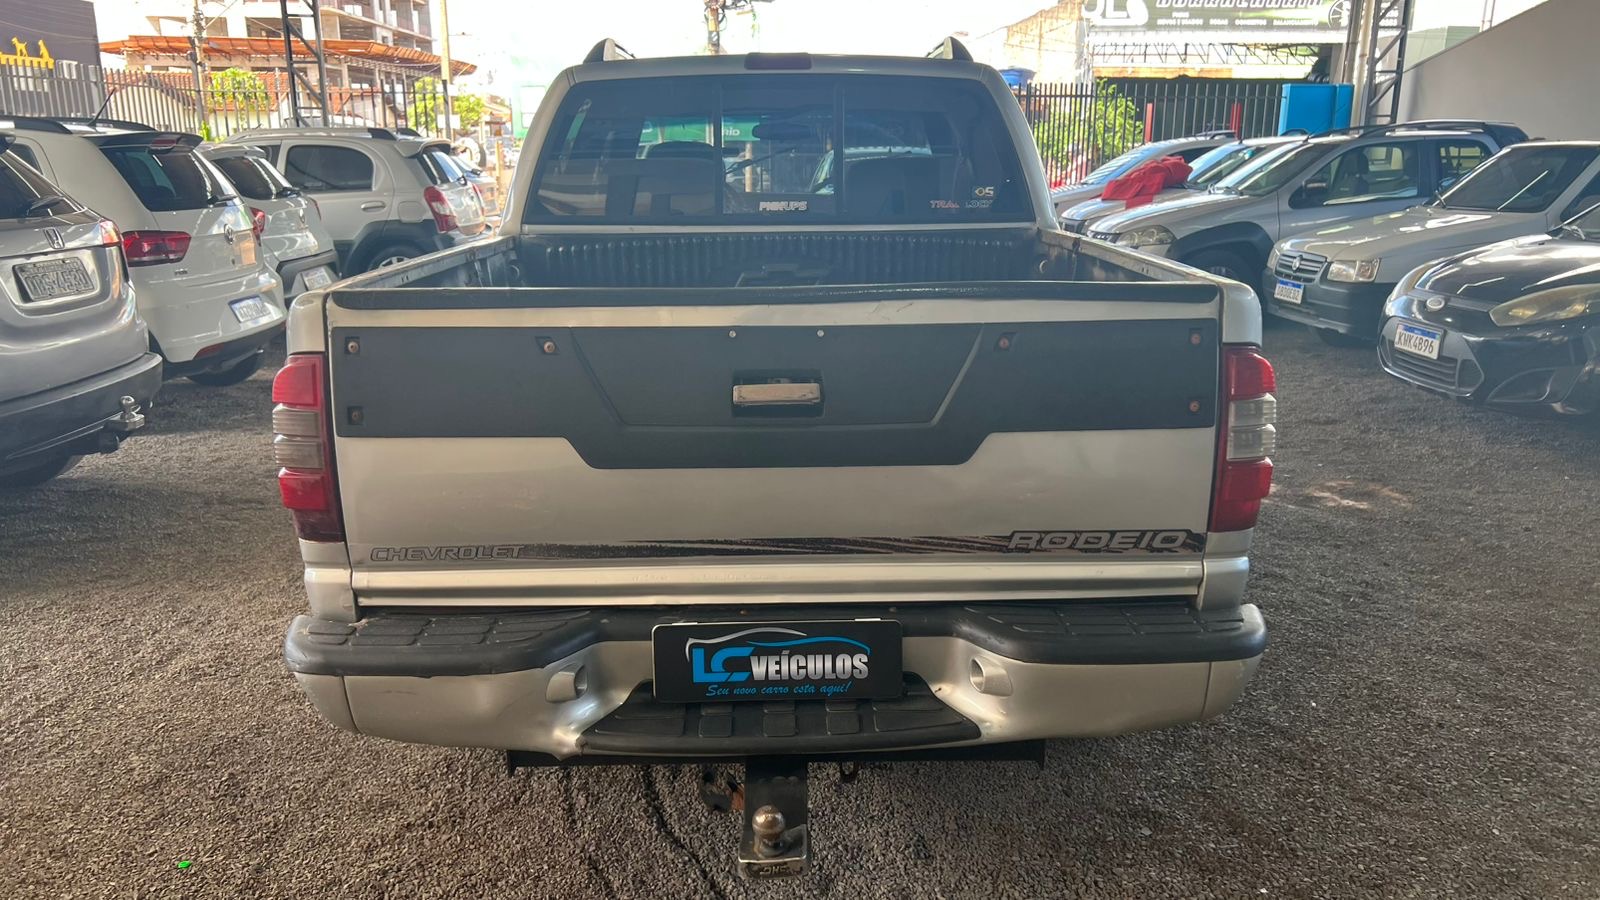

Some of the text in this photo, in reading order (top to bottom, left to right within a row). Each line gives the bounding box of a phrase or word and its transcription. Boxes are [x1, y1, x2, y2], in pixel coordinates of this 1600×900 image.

[370, 530, 1188, 562] CHEVROLET RODEIO
[692, 646, 869, 683] LC VEÍCULOS
[706, 681, 852, 697] Seu novo carro esta aqui!
